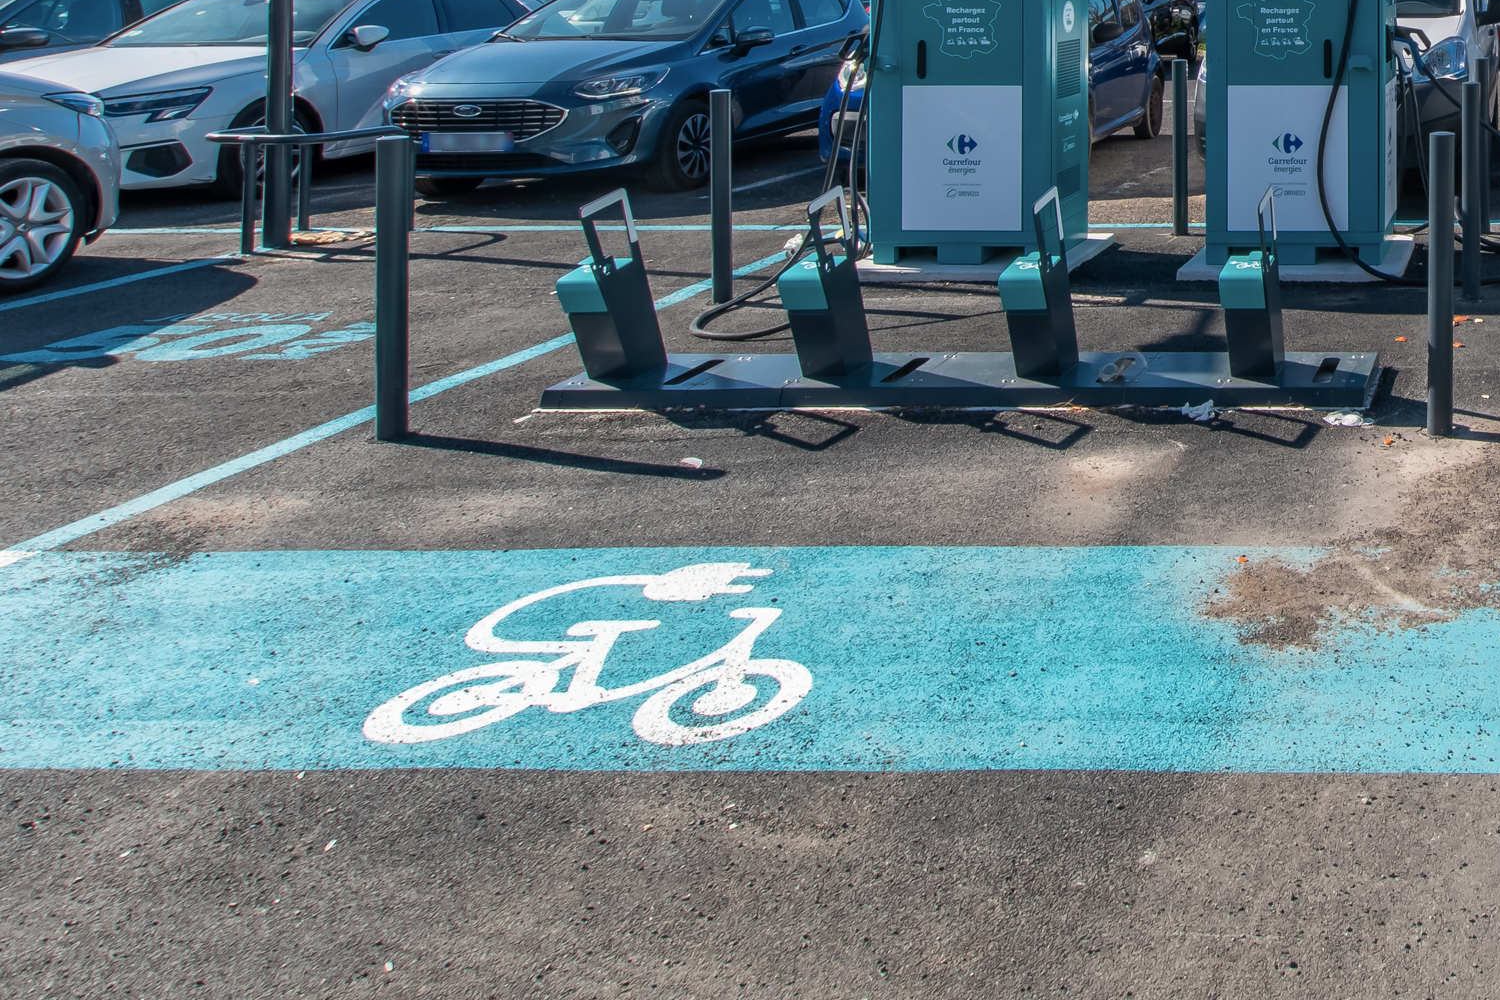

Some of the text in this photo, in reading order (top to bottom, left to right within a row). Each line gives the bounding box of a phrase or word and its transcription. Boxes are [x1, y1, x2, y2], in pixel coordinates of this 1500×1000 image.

[946, 7, 986, 15] Rechargez
[1260, 7, 1300, 15] Rechargez
[951, 16, 980, 25] partout
[1265, 16, 1294, 25] partout
[942, 158, 982, 166] Carrefour
[1268, 157, 1308, 165] Carrefour
[948, 166, 976, 176] énergies
[1273, 165, 1302, 175] énergies
[0, 324, 312, 362] 50
